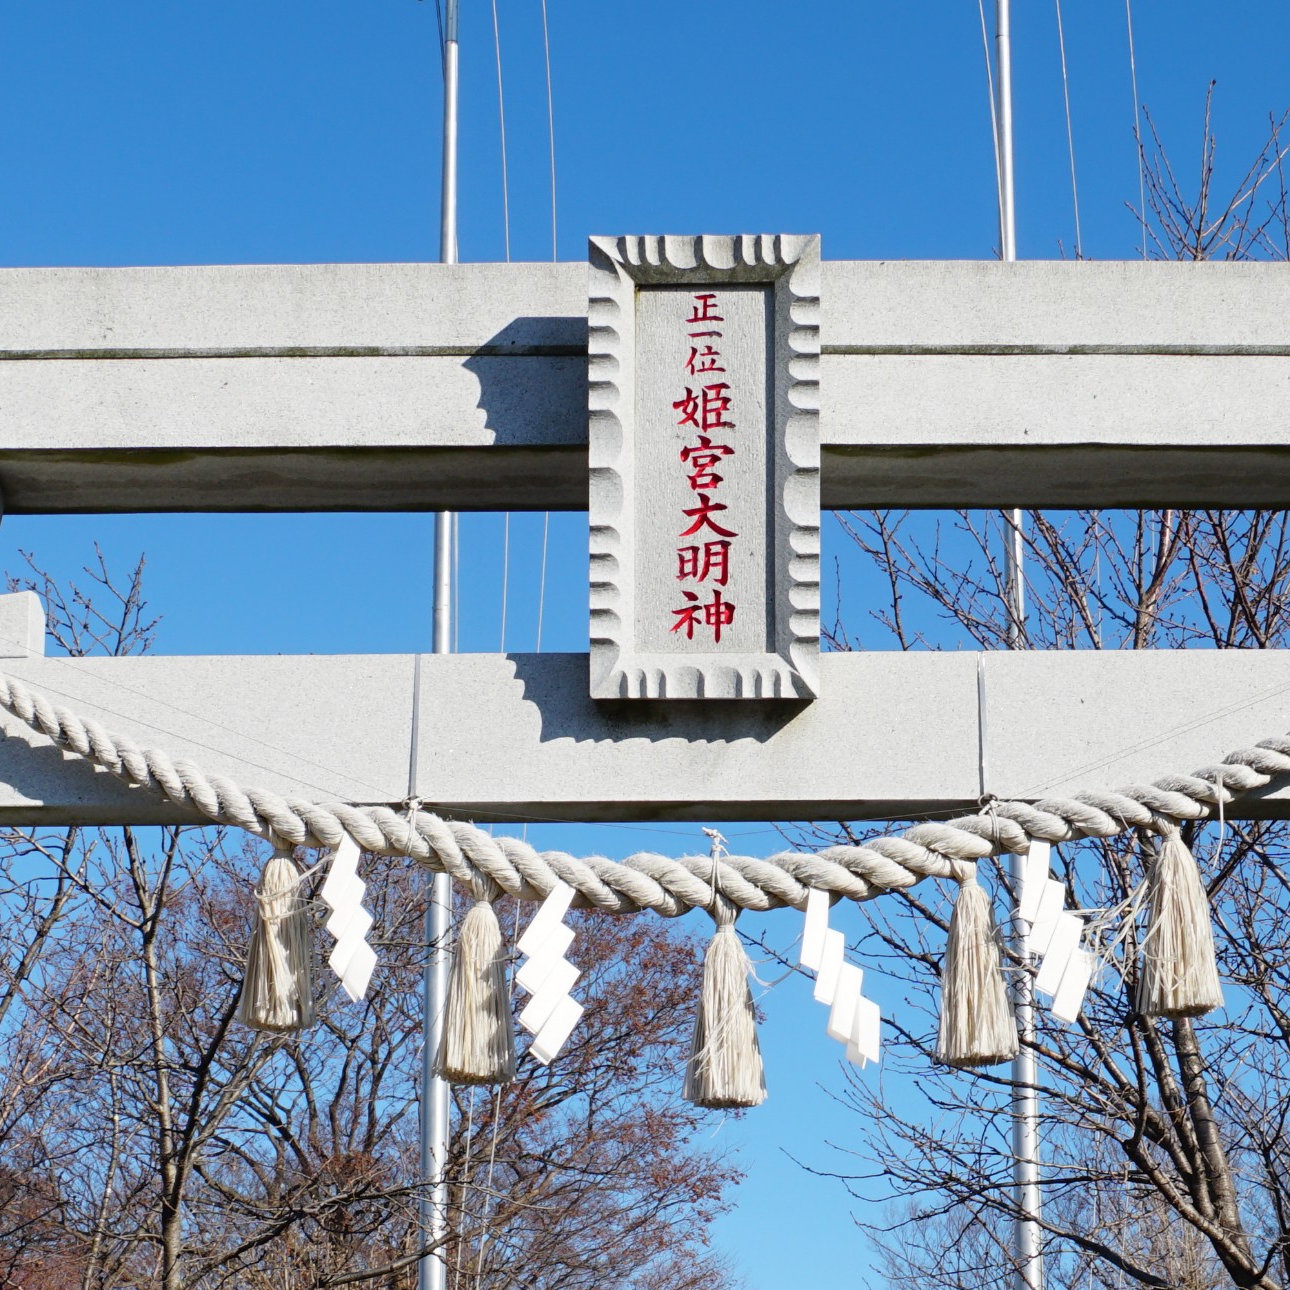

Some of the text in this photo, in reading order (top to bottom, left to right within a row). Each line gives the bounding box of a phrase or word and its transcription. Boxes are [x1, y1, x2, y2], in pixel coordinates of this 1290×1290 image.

[671, 293, 739, 645] 正一位姫宮大明神
